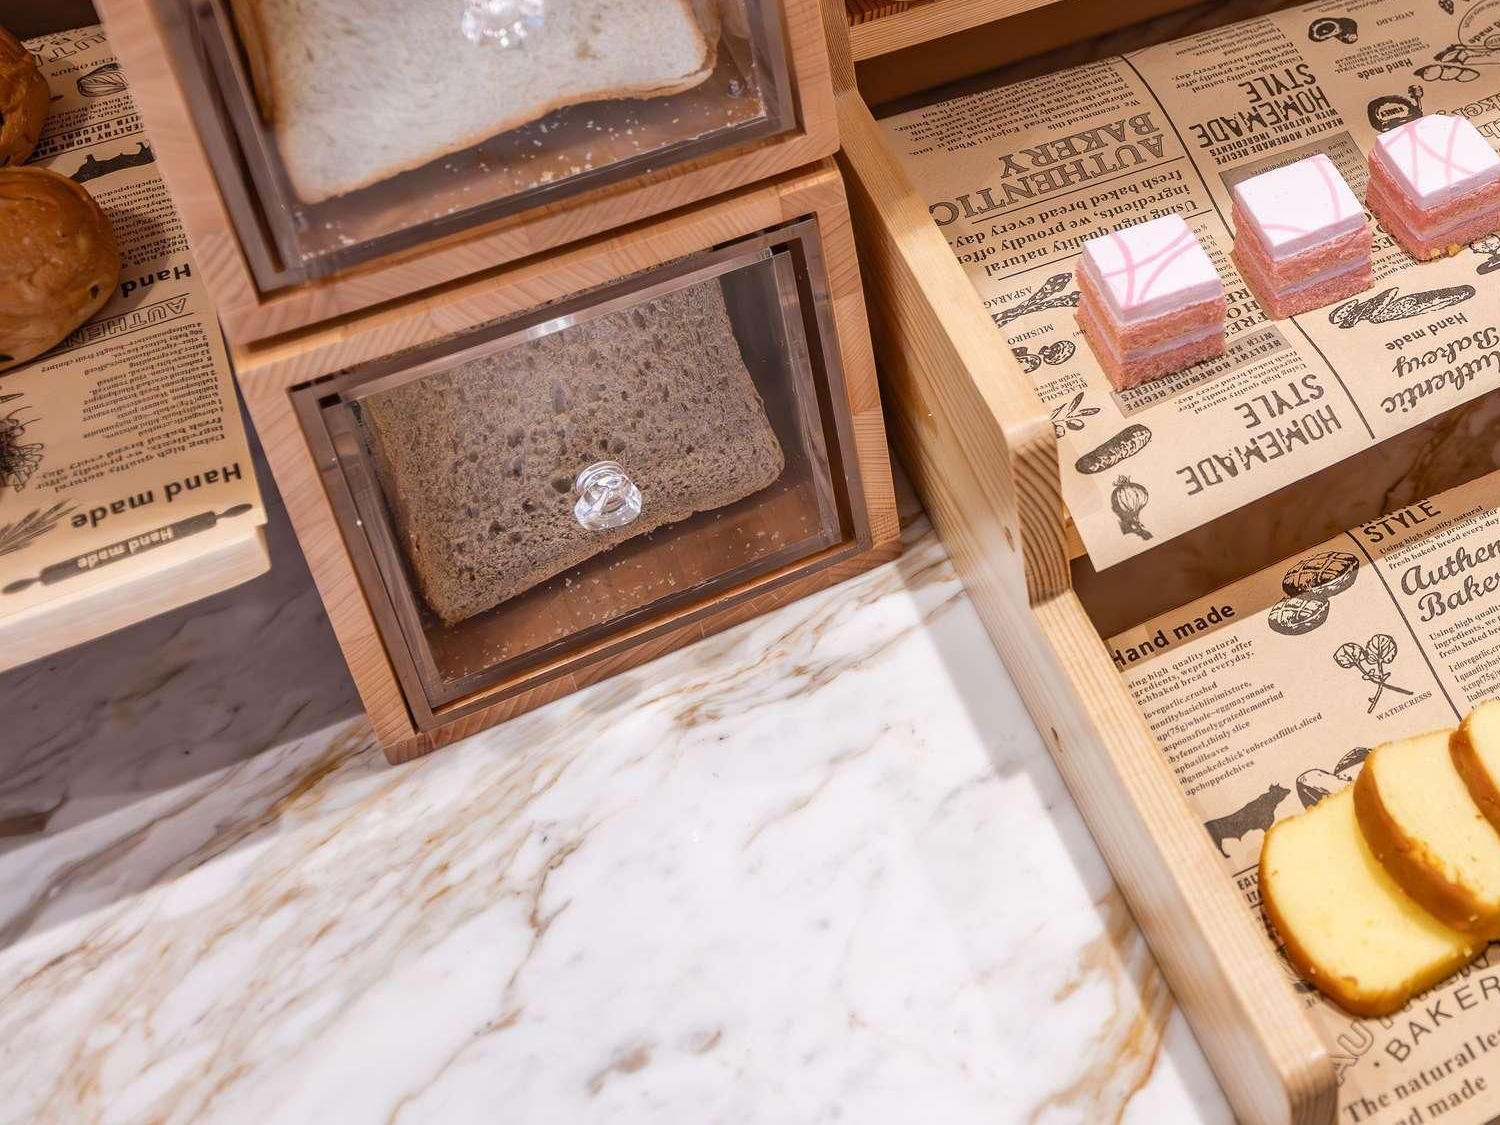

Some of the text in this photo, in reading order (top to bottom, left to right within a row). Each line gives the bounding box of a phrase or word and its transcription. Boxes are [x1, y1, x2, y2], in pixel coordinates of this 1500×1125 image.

[1238, 64, 1317, 103] STYLE
[1356, 58, 1414, 80] Hand made
[1189, 86, 1332, 148] HOMEMADE
[1272, 115, 1312, 133] NATURAL
[997, 112, 1159, 179] BAKERY
[1209, 131, 1270, 156] INGREDIENTS
[1215, 147, 1249, 165] RECIPE
[1250, 132, 1303, 153] HOMEMADE
[928, 133, 1164, 226] AUTHENTIC
[947, 170, 1183, 248] fresh baked bread every day.
[1094, 184, 1191, 219] ingredients,
[1001, 220, 1071, 252] proudly
[1071, 216, 1092, 232] we
[120, 263, 192, 299] Hand
[1385, 313, 1469, 352] Hand made
[1392, 327, 1500, 378] Bakery
[1235, 374, 1325, 429] STYLE
[1176, 404, 1342, 496] HOMEMADE
[70, 462, 242, 530] Hand made
[1364, 500, 1442, 543] STYLE
[78, 528, 173, 570] Hand made
[1173, 604, 1236, 639] made
[1428, 624, 1456, 641] Using
[1455, 615, 1474, 631] high
[1433, 625, 1485, 651] ingredients,
[1484, 618, 1497, 627] we
[1342, 1092, 1396, 1125] The
[1393, 1042, 1478, 1100] natural
[1427, 1074, 1489, 1122] made
